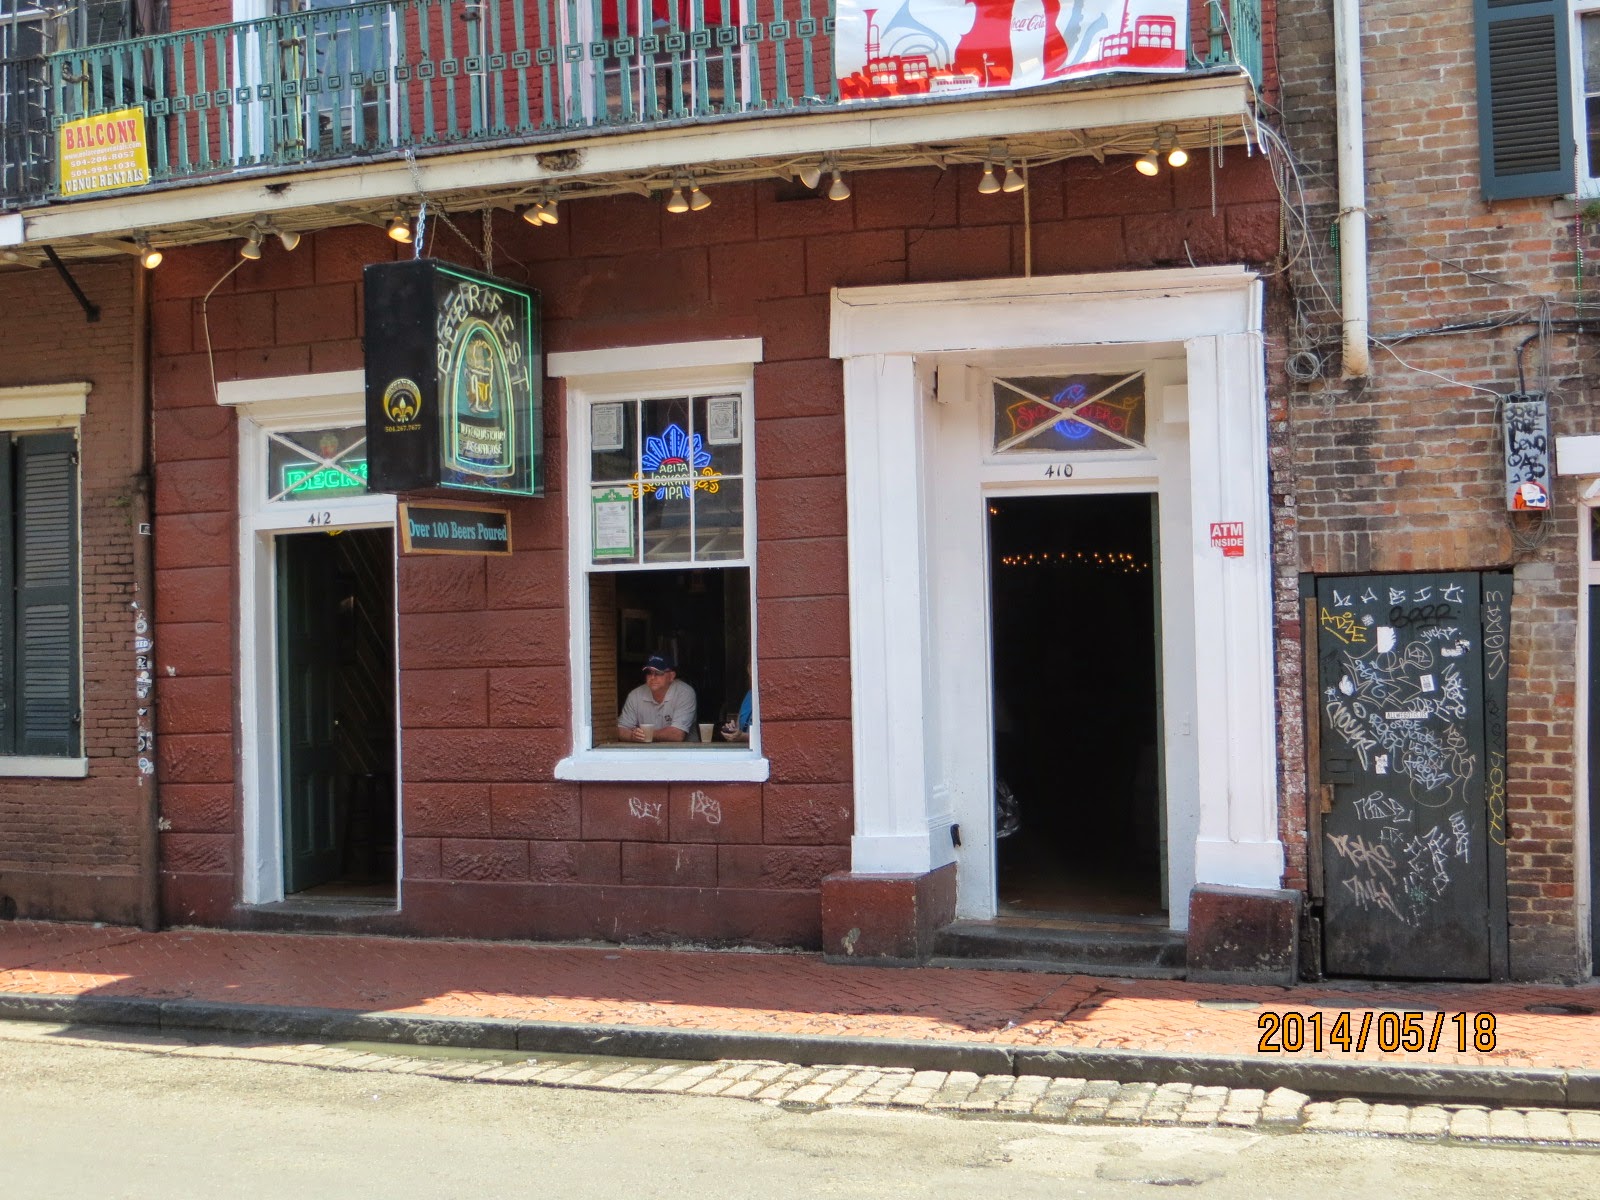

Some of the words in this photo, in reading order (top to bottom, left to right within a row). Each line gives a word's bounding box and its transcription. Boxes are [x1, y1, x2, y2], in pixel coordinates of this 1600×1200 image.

[65, 119, 137, 150] BALCONY
[70, 150, 135, 168] 504-206-8057
[71, 161, 136, 178] 504-994-1036
[65, 175, 97, 193] VENUE
[99, 168, 144, 187] RENTALS
[659, 463, 689, 474] ABITA
[1045, 463, 1073, 478] 410
[665, 486, 684, 500] IPA
[308, 511, 331, 526] 412
[408, 518, 430, 538] Over
[432, 521, 450, 538] 100
[450, 521, 476, 540] Beers
[477, 522, 508, 541] Poured
[1212, 523, 1242, 537] ATM
[1211, 537, 1244, 547] INSIDE
